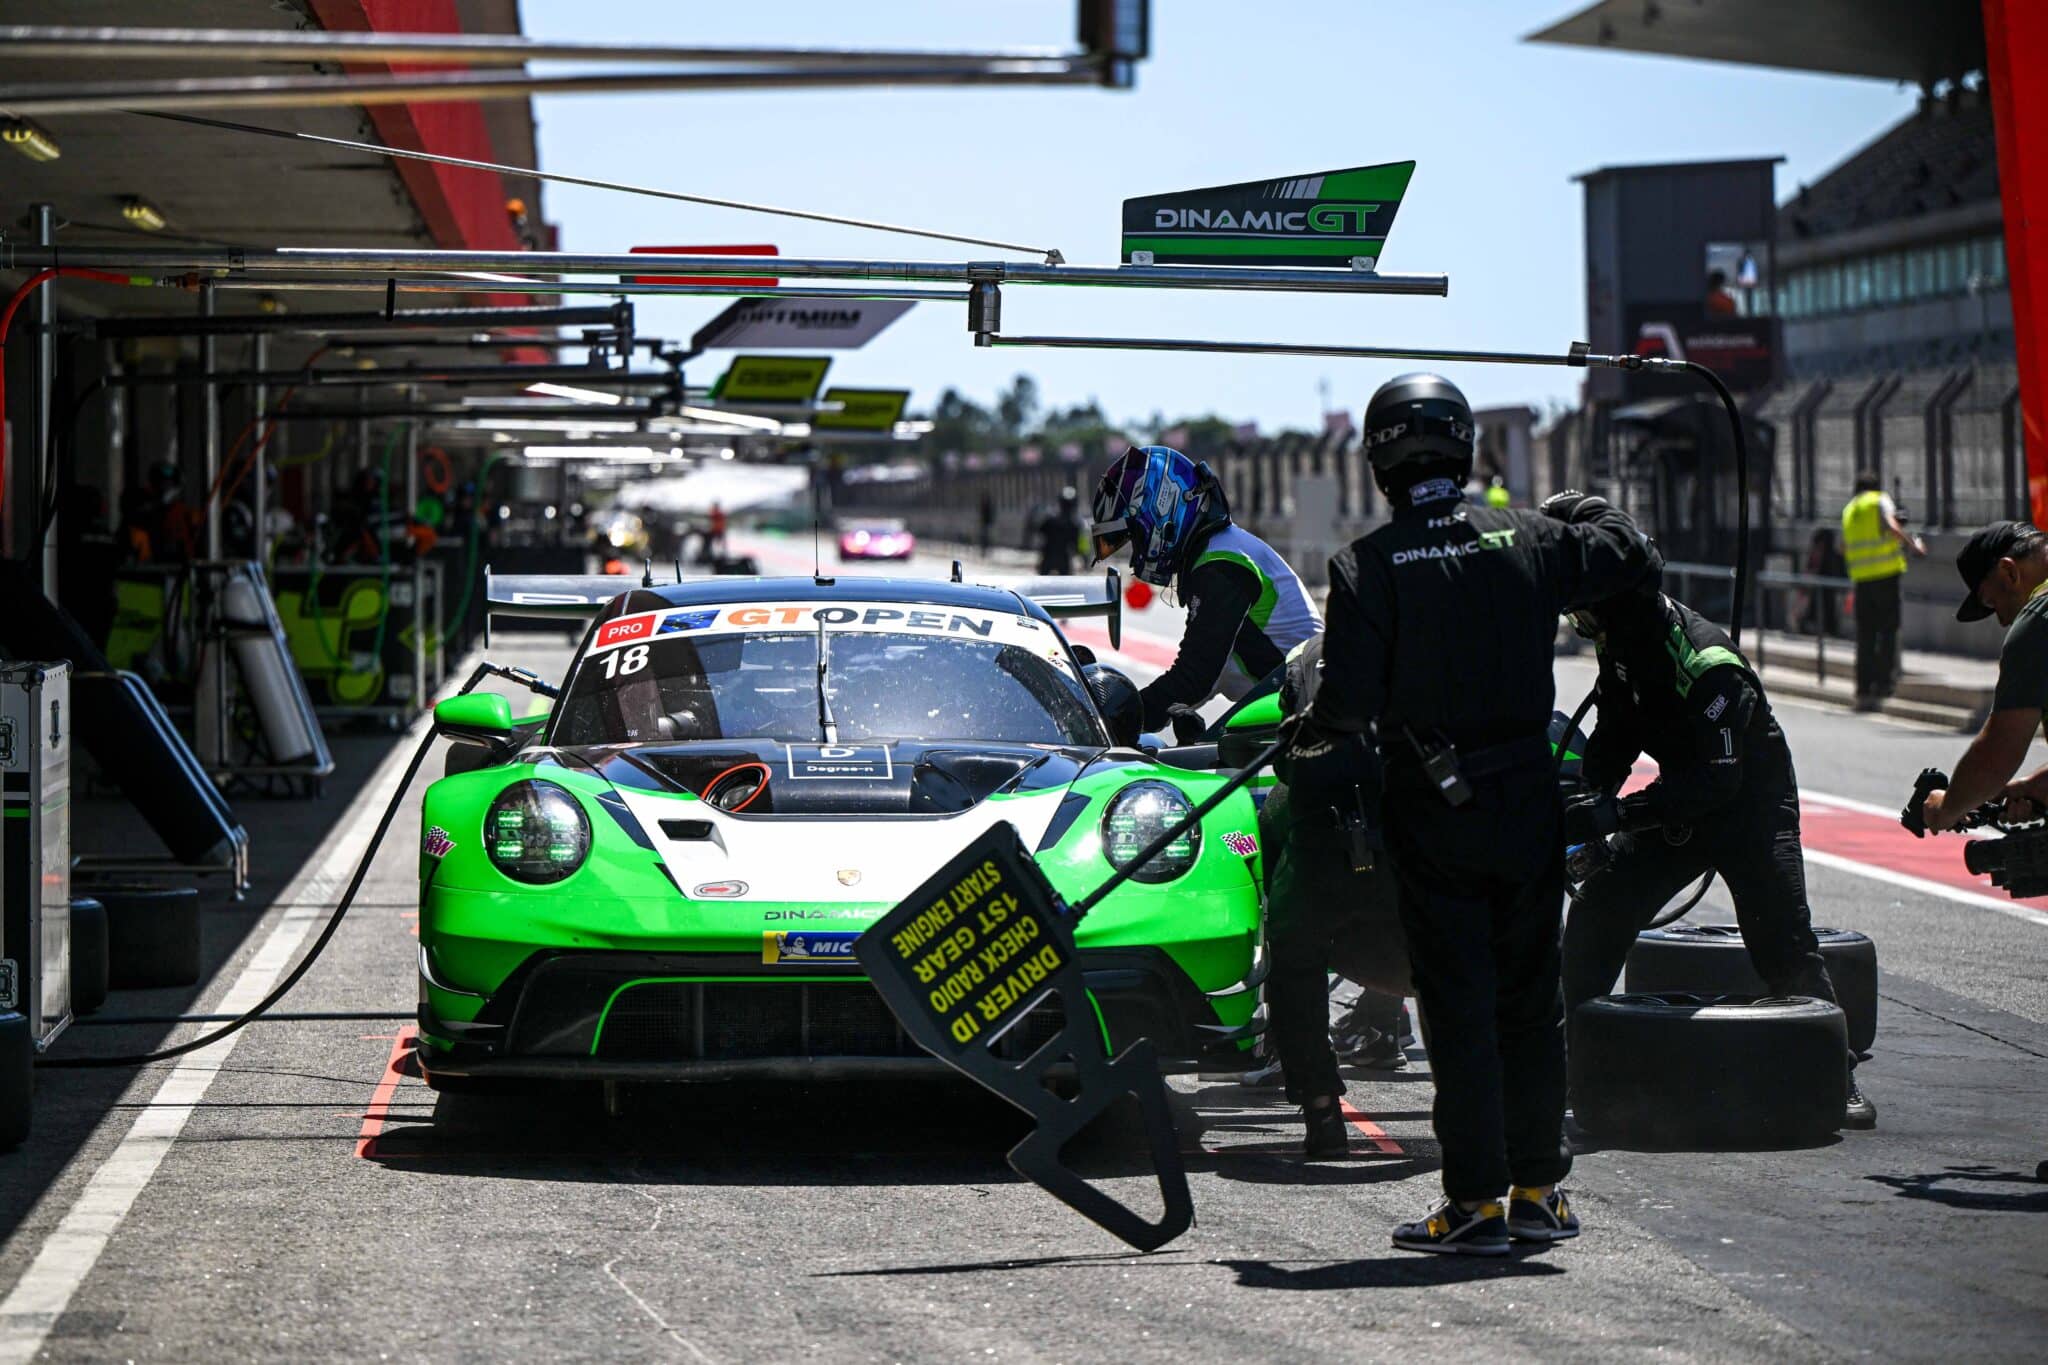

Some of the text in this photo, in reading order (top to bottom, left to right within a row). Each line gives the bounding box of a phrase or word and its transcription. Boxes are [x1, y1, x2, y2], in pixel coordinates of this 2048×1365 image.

[607, 622, 643, 638] PRO
[600, 644, 650, 679] 18
[1706, 694, 1728, 720] OMP
[1719, 727, 1733, 756] 1
[806, 765, 874, 773] Degree-n
[892, 860, 1002, 959] START ENGINE
[912, 892, 1018, 984] 1ST GEAR
[929, 915, 1040, 1014] CHECK RADIO
[951, 944, 1061, 1044] DRIVER ID
